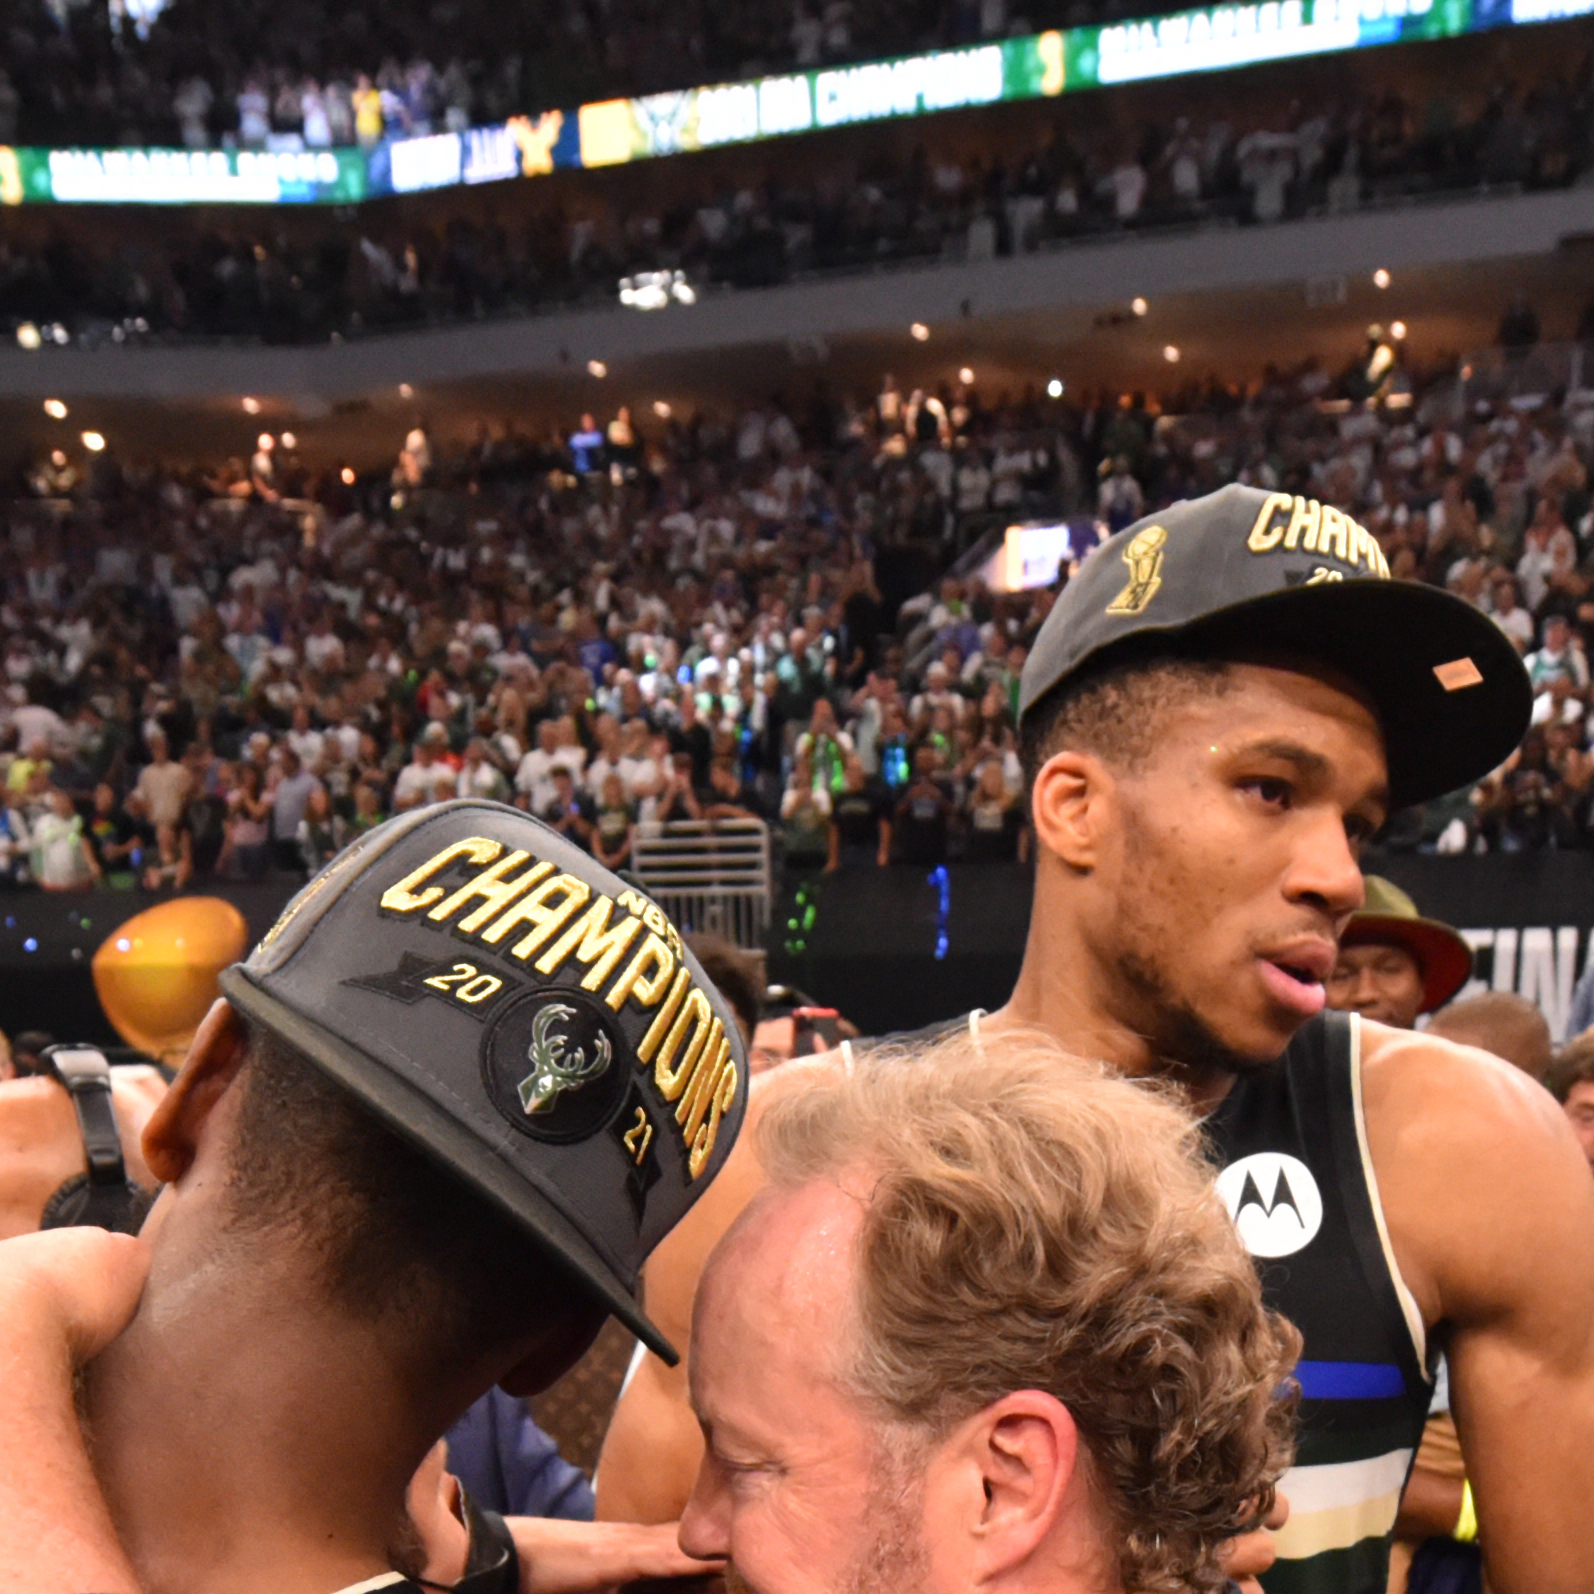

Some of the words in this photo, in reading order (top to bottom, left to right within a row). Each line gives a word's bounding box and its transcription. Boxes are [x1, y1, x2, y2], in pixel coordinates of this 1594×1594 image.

[380, 836, 739, 1181] CHAMPIONS
[423, 963, 503, 1004] 20
[623, 1105, 654, 1167] 21
